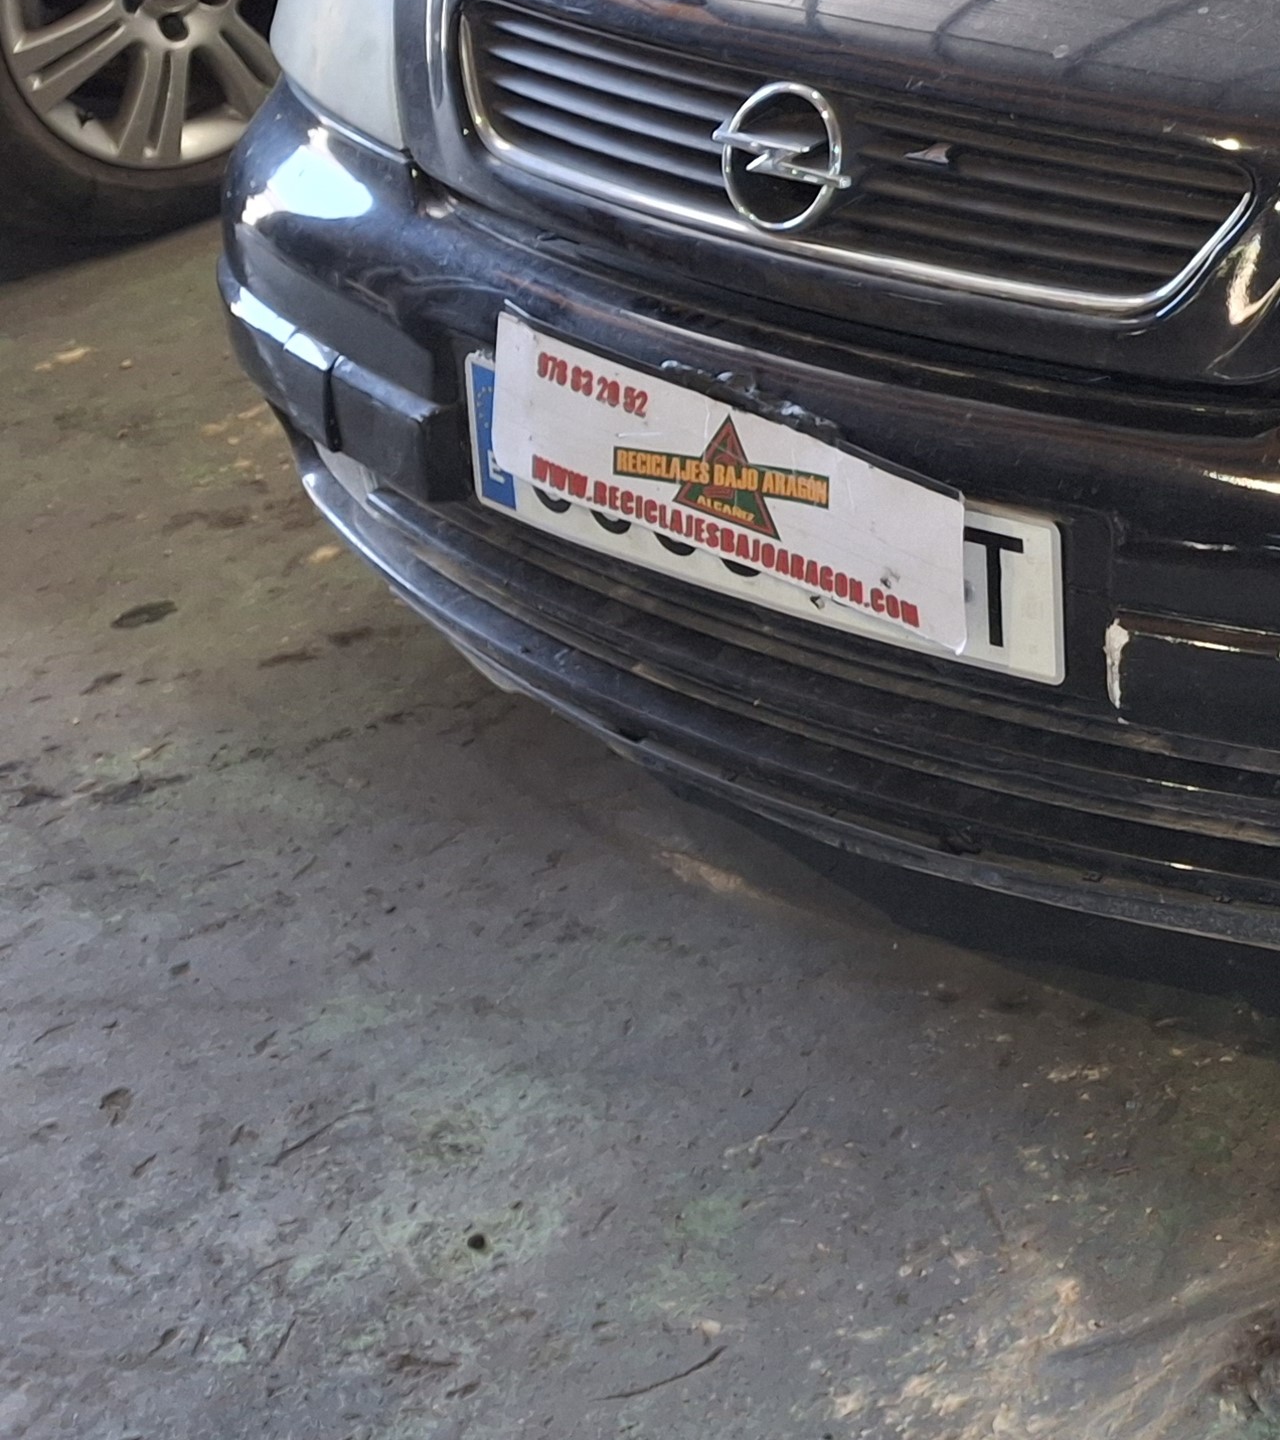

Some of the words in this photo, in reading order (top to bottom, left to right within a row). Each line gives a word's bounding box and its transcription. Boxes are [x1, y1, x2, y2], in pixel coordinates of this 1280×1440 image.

[623, 386, 649, 419] 52
[616, 449, 710, 485] RECICLAJES
[713, 463, 759, 491] BAJO
[762, 471, 828, 505] ARAGÓN
[531, 453, 920, 628] WWW.RECICLAJESBAJOARAGON.COM
